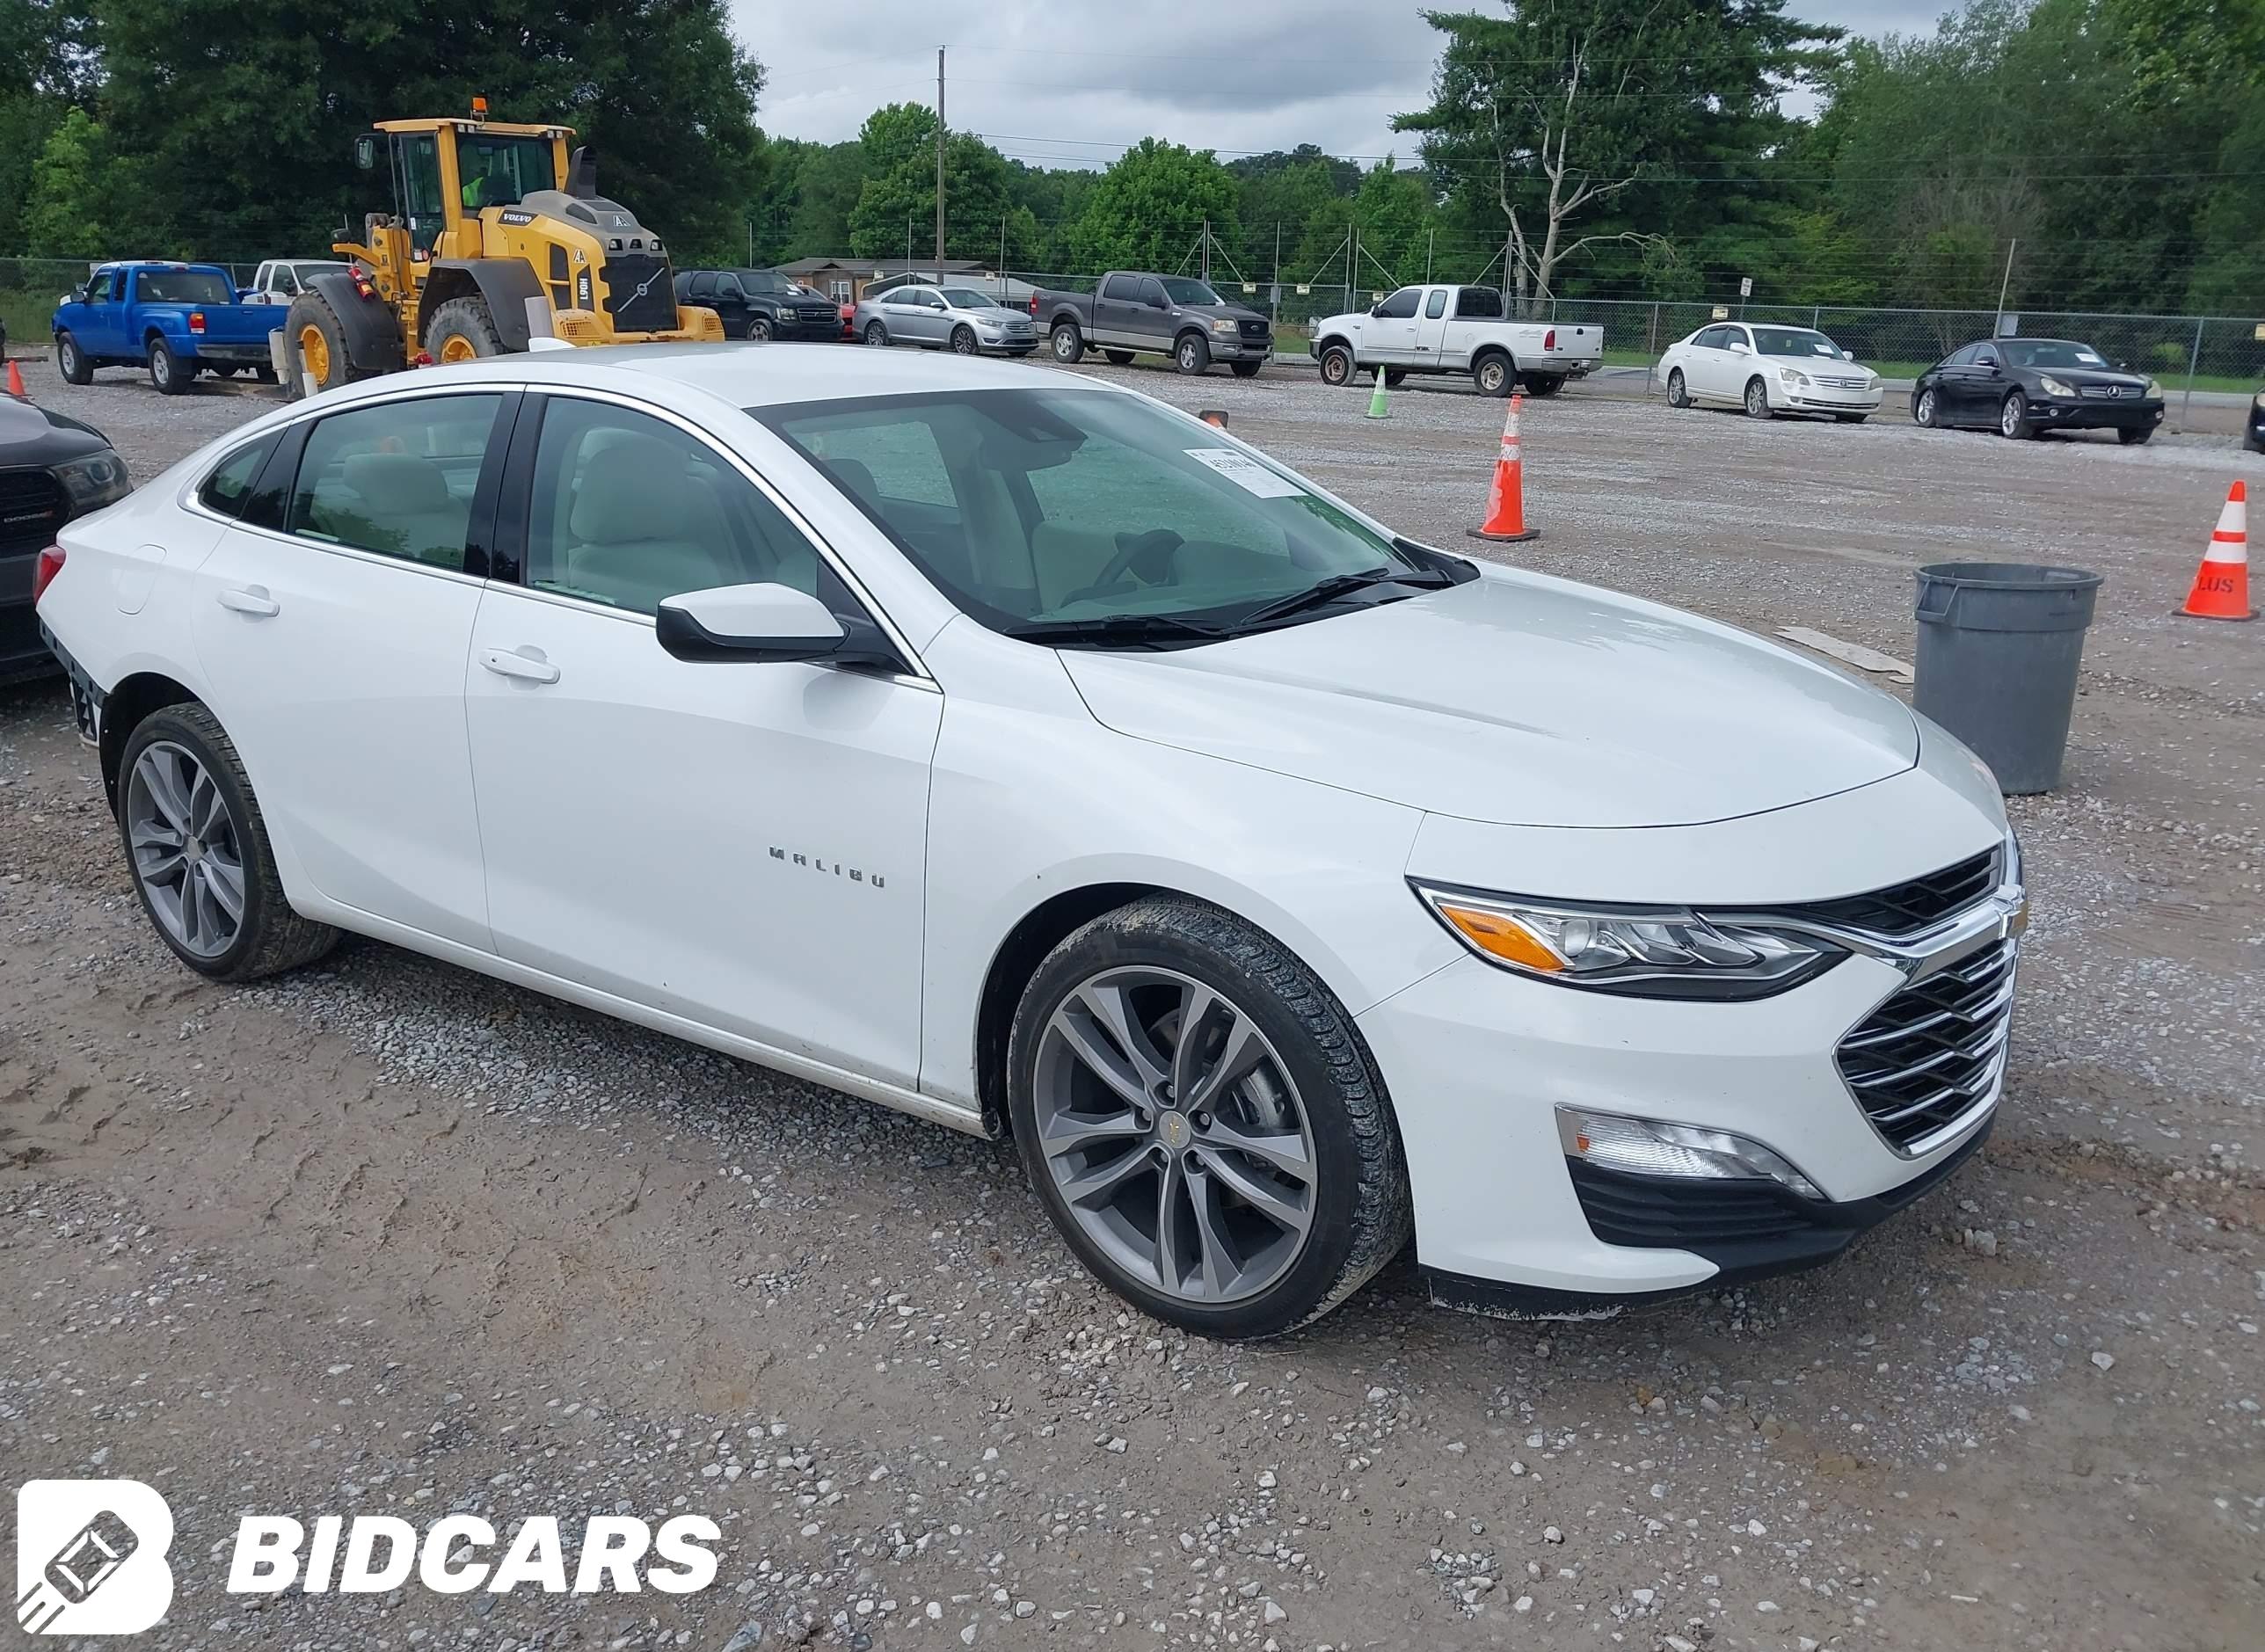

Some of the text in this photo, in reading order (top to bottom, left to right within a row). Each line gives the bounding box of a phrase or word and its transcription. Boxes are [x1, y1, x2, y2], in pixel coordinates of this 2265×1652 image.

[504, 214, 532, 222] VOLVO
[579, 278, 588, 300] L90H
[769, 845, 885, 888] MALIBU
